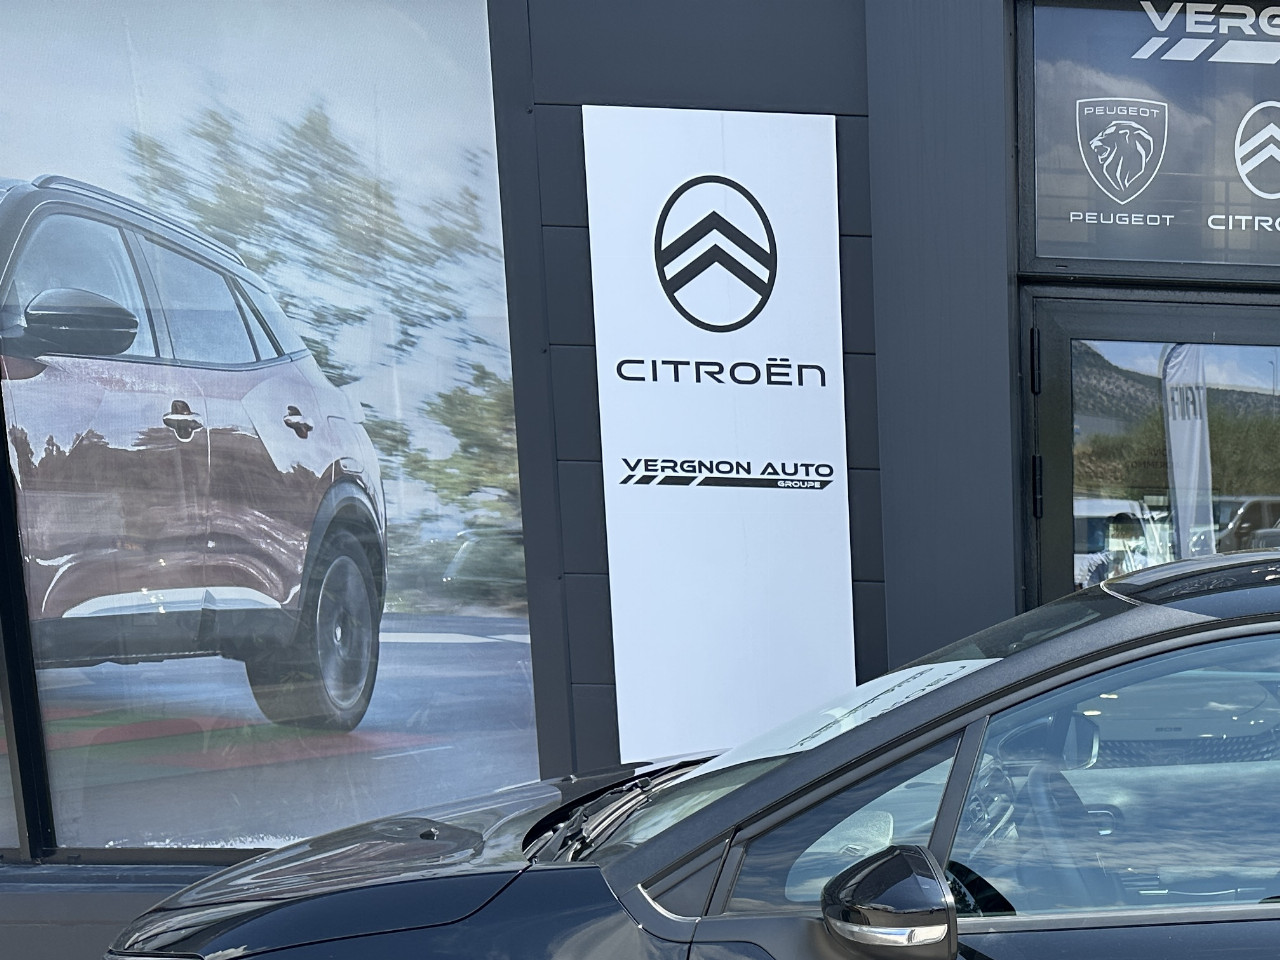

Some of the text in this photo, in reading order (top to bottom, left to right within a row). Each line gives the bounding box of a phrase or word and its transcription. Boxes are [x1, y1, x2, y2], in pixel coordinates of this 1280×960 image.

[1084, 105, 1160, 119] PEUGEOT
[1070, 210, 1175, 226] PEUGEOT
[1169, 385, 1205, 421] FIAT
[621, 457, 834, 478] VERGNON AUTO
[777, 480, 821, 489] GROUPE
